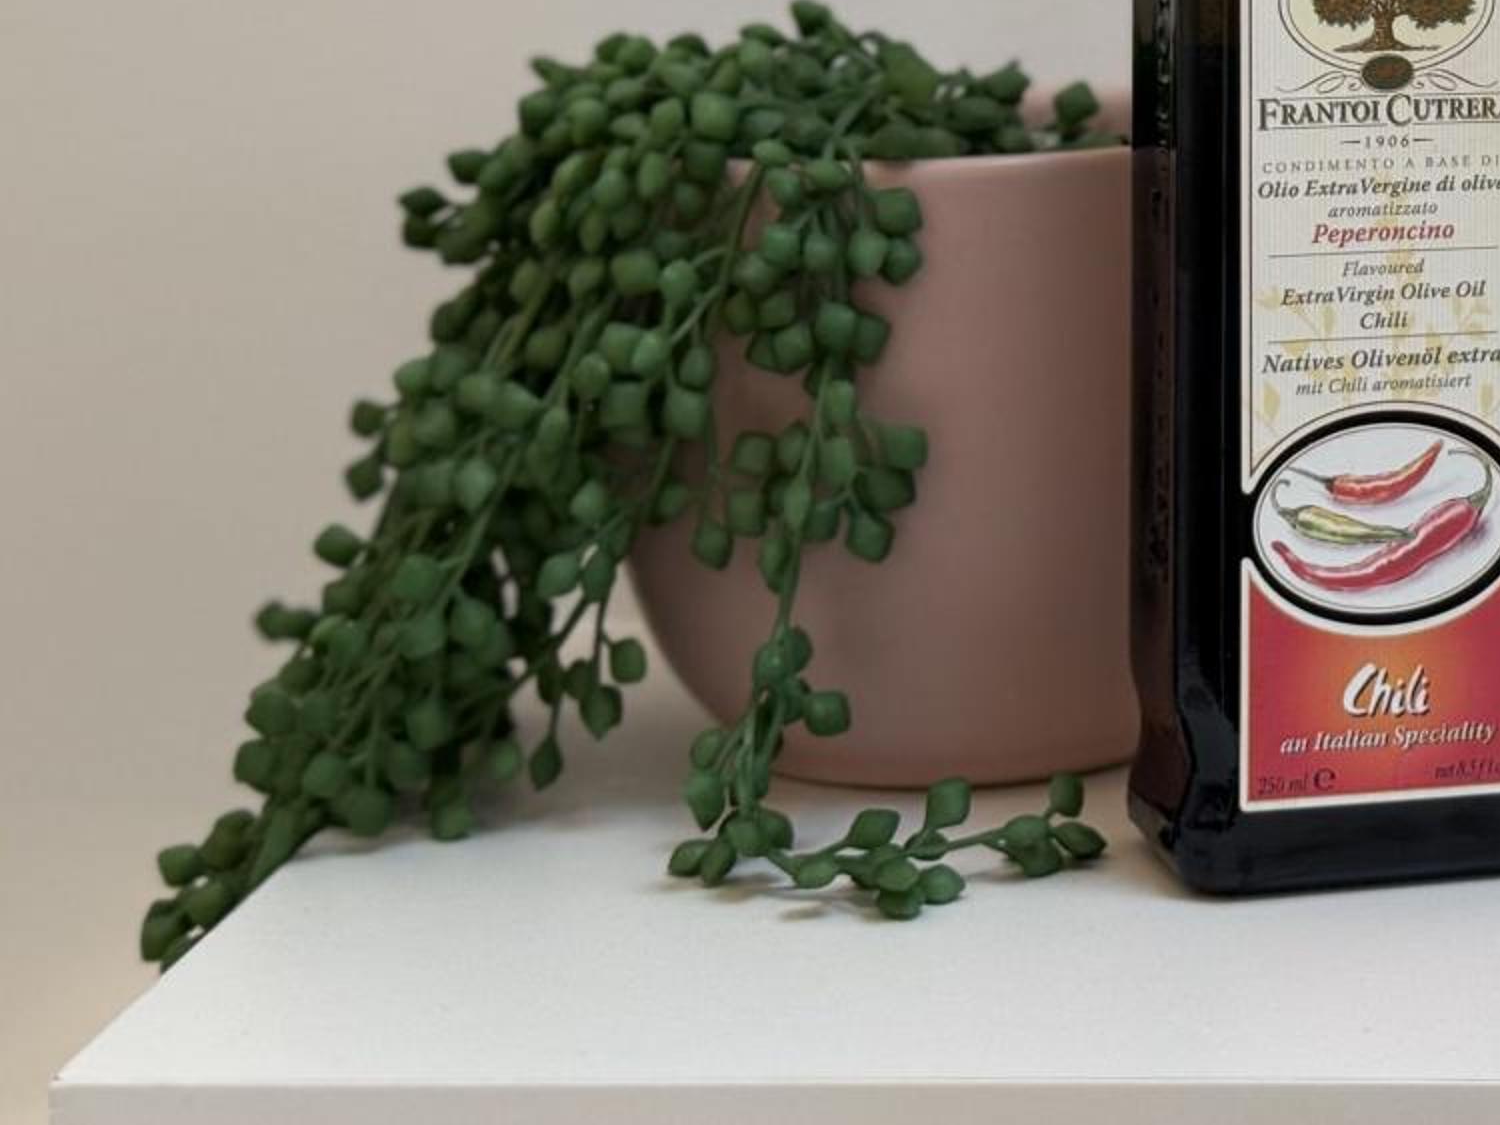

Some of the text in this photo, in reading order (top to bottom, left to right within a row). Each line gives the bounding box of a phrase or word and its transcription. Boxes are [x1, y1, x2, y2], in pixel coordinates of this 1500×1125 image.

[1256, 98, 1380, 131] FRANTOI
[1364, 135, 1409, 149] 1906
[1262, 157, 1394, 174] CONDIMENTO
[1425, 155, 1471, 168] BASE
[1481, 154, 1499, 166] DI
[1257, 180, 1299, 199] Olio
[1435, 175, 1455, 192] di
[1327, 201, 1438, 219] aromatizzato
[1311, 220, 1455, 248] Peperoncino
[1342, 258, 1425, 277] Flavoured
[1401, 283, 1450, 300] Olive
[1455, 280, 1486, 298] Oil
[1359, 311, 1408, 330] Chili
[1261, 353, 1344, 374] Natives
[1351, 347, 1442, 369] Olivenöl
[1296, 375, 1472, 396] mit Chili aromatisiert
[1343, 663, 1431, 718] Chili
[1280, 721, 1497, 755] an Italian Speciality
